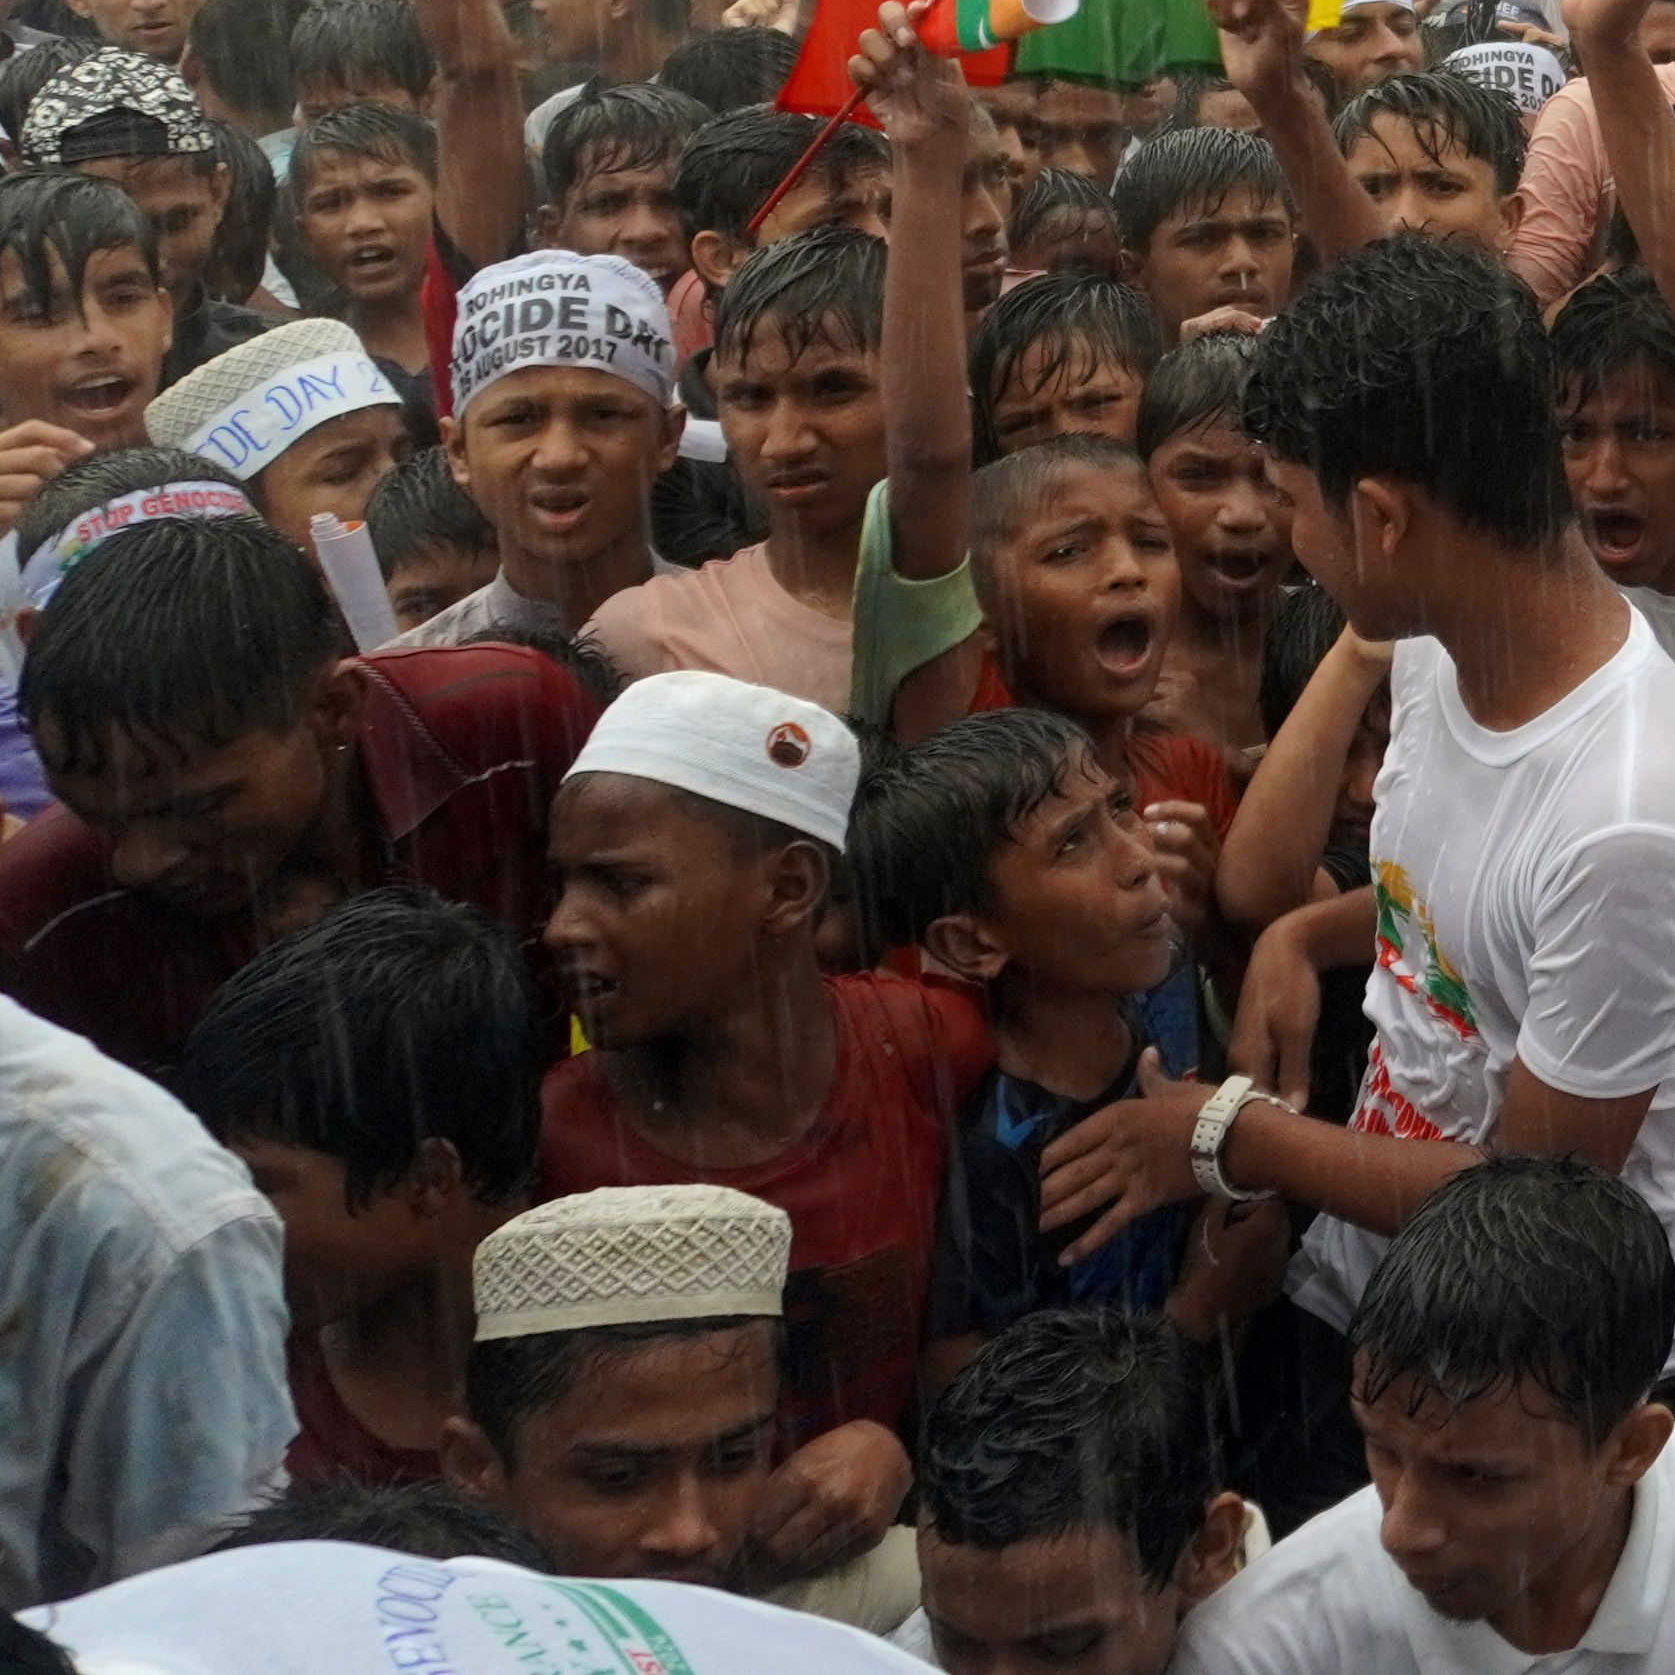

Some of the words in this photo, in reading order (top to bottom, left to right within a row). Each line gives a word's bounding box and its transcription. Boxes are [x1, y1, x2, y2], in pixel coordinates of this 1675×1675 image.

[464, 273, 592, 319] ROHINGYA
[556, 332, 618, 364] 2017
[263, 364, 347, 431] DAY
[77, 505, 134, 544] STOP
